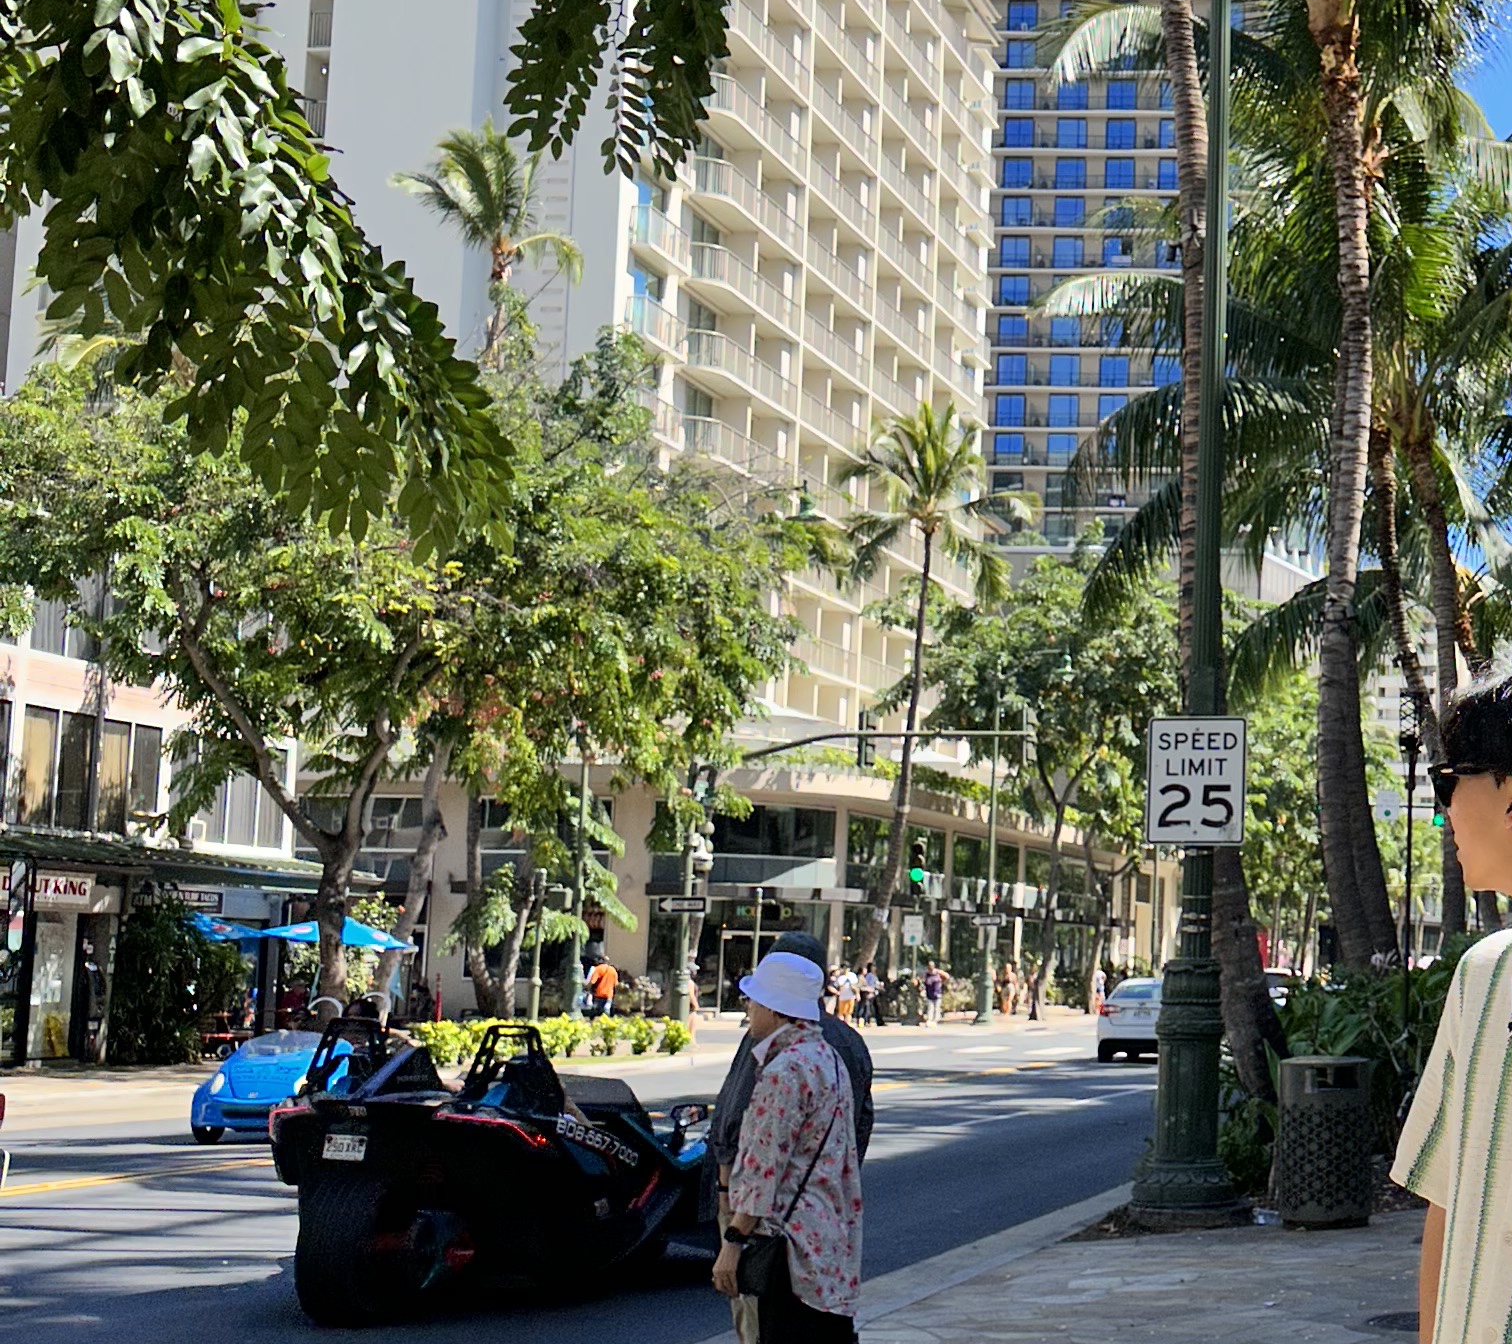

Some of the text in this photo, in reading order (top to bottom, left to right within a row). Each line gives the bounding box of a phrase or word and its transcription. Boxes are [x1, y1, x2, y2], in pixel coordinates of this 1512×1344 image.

[1158, 732, 1238, 751] SPEED
[1166, 758, 1228, 776] LIMIT
[1158, 783, 1234, 828] 25
[2, 875, 50, 895] DUT
